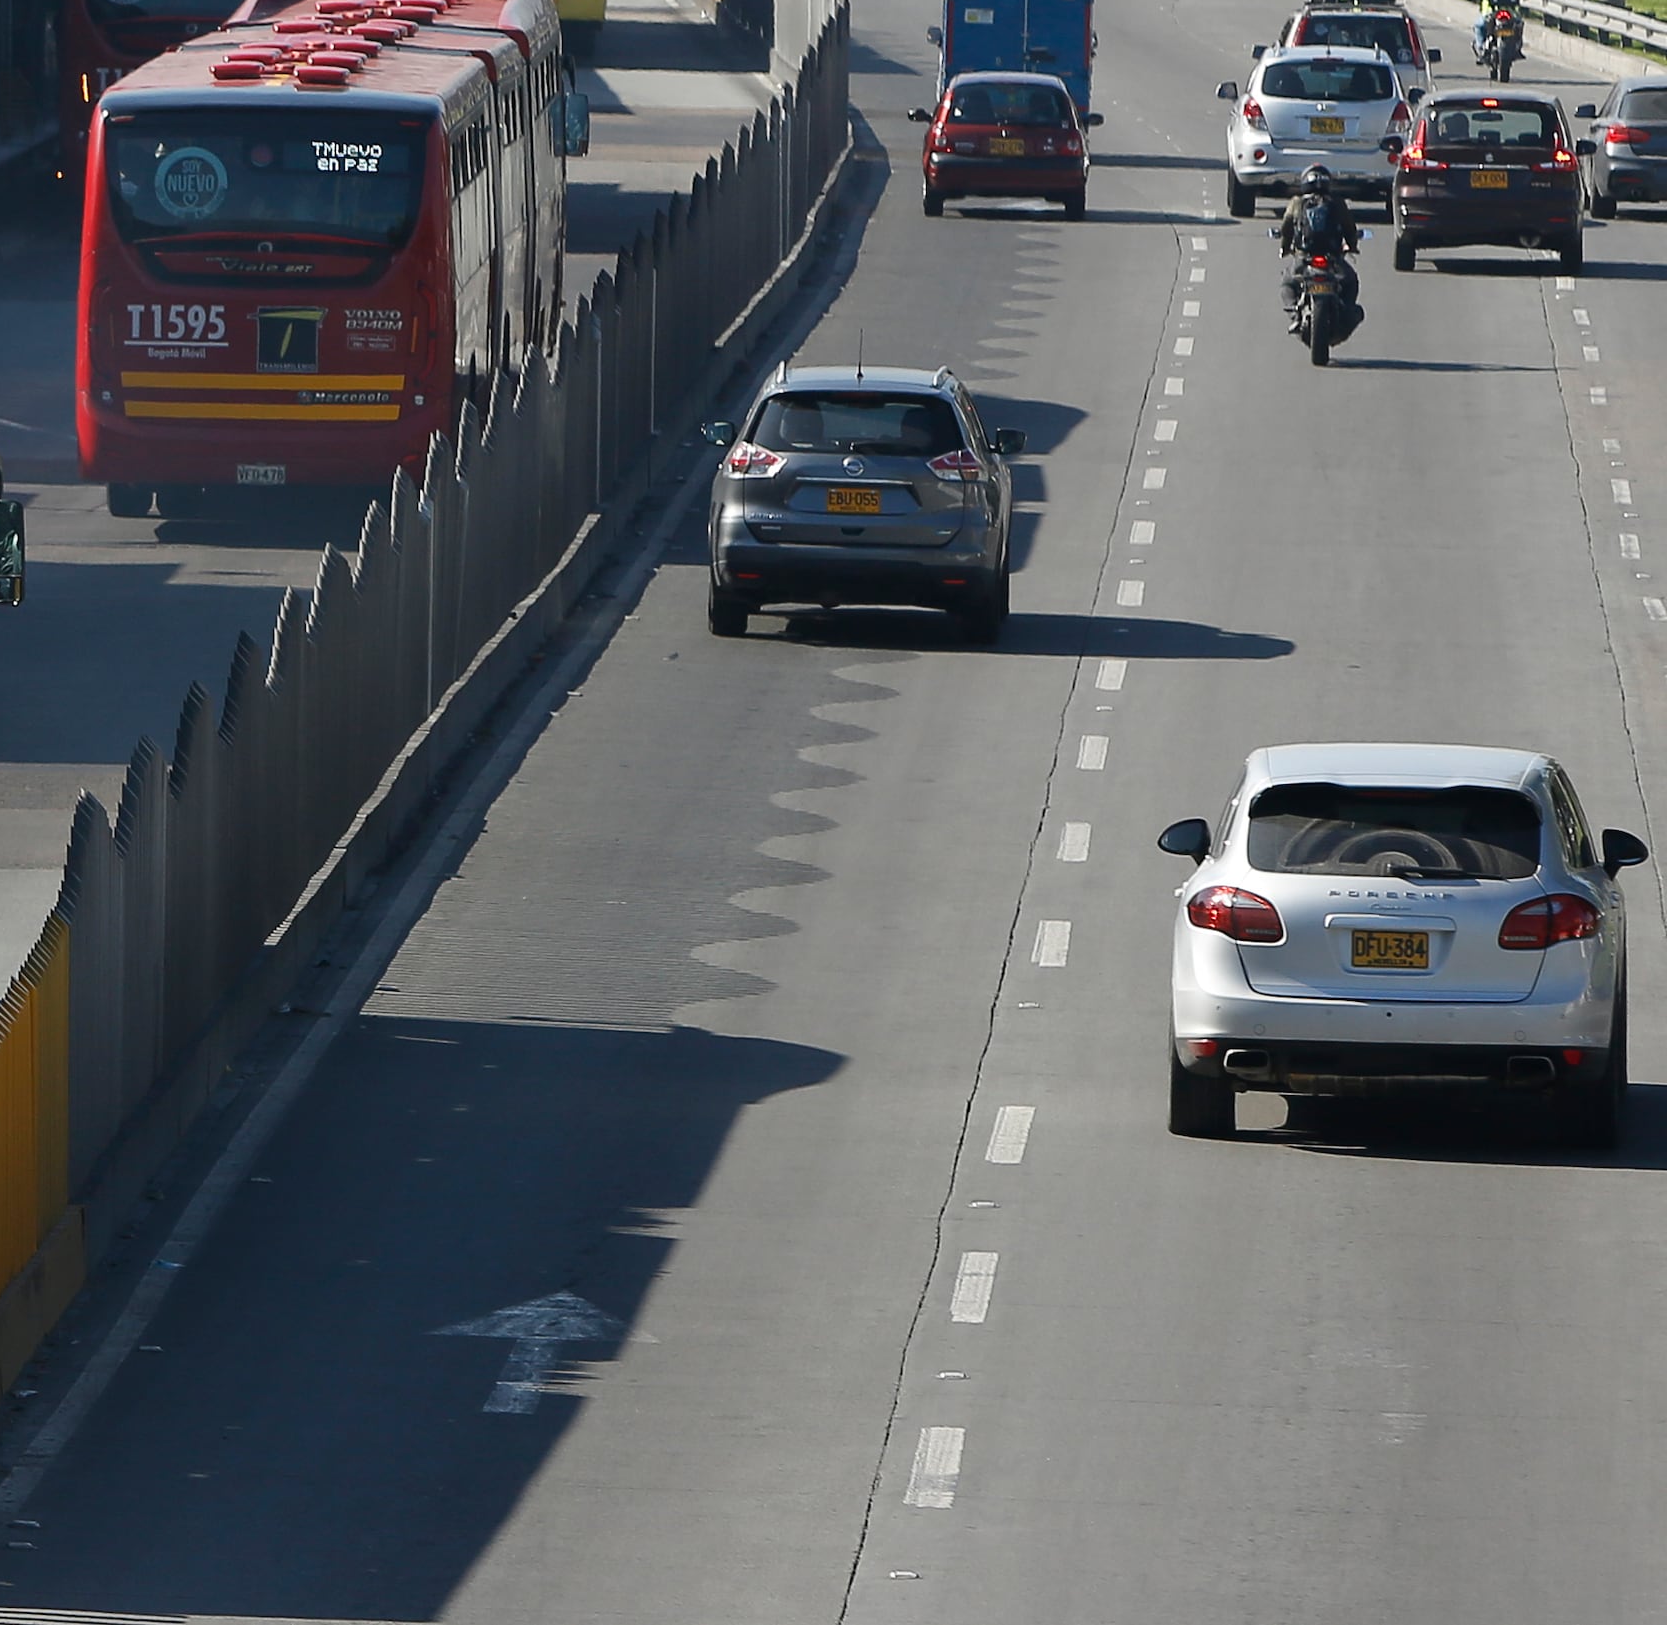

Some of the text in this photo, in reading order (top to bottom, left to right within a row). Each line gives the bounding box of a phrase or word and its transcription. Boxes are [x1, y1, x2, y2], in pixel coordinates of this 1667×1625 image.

[182, 160, 203, 172] SOY
[167, 174, 215, 192] NUEVO
[127, 304, 226, 340] T1595
[344, 309, 402, 319] VOLVO
[315, 391, 390, 404] Marcopolo
[827, 490, 879, 507] EBU-055
[1355, 935, 1427, 959] DFU-384
